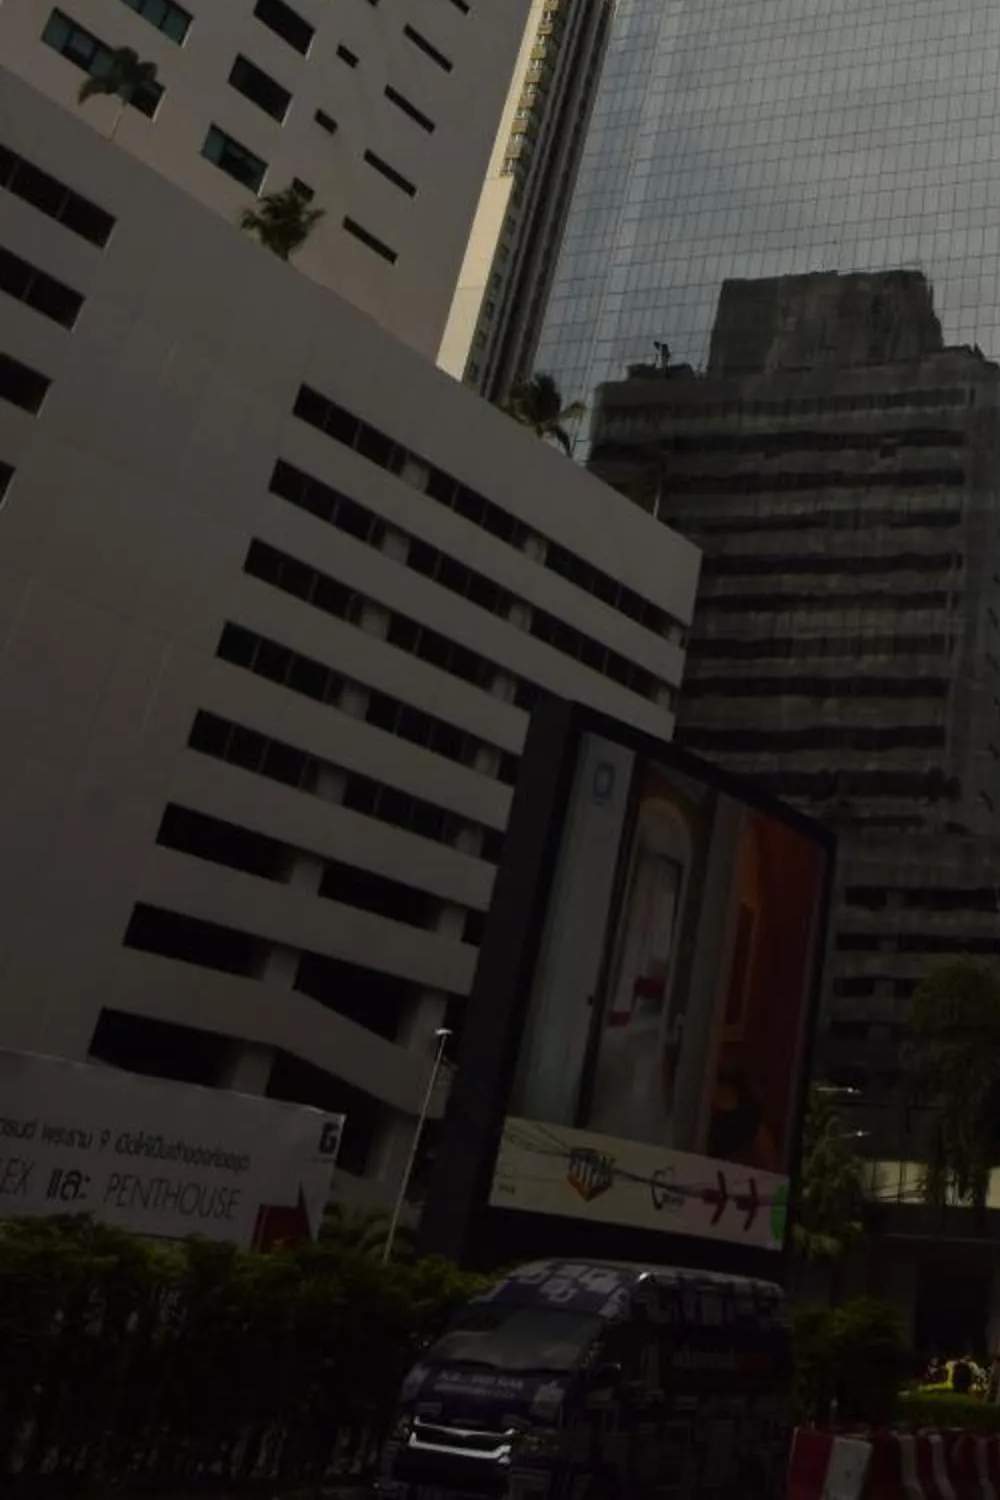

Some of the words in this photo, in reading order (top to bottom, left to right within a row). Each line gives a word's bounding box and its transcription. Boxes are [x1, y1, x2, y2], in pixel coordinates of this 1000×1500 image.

[0, 1157, 36, 1197] EX
[46, 1167, 93, 1201] และ
[102, 1171, 242, 1220] PENTHOUSE
